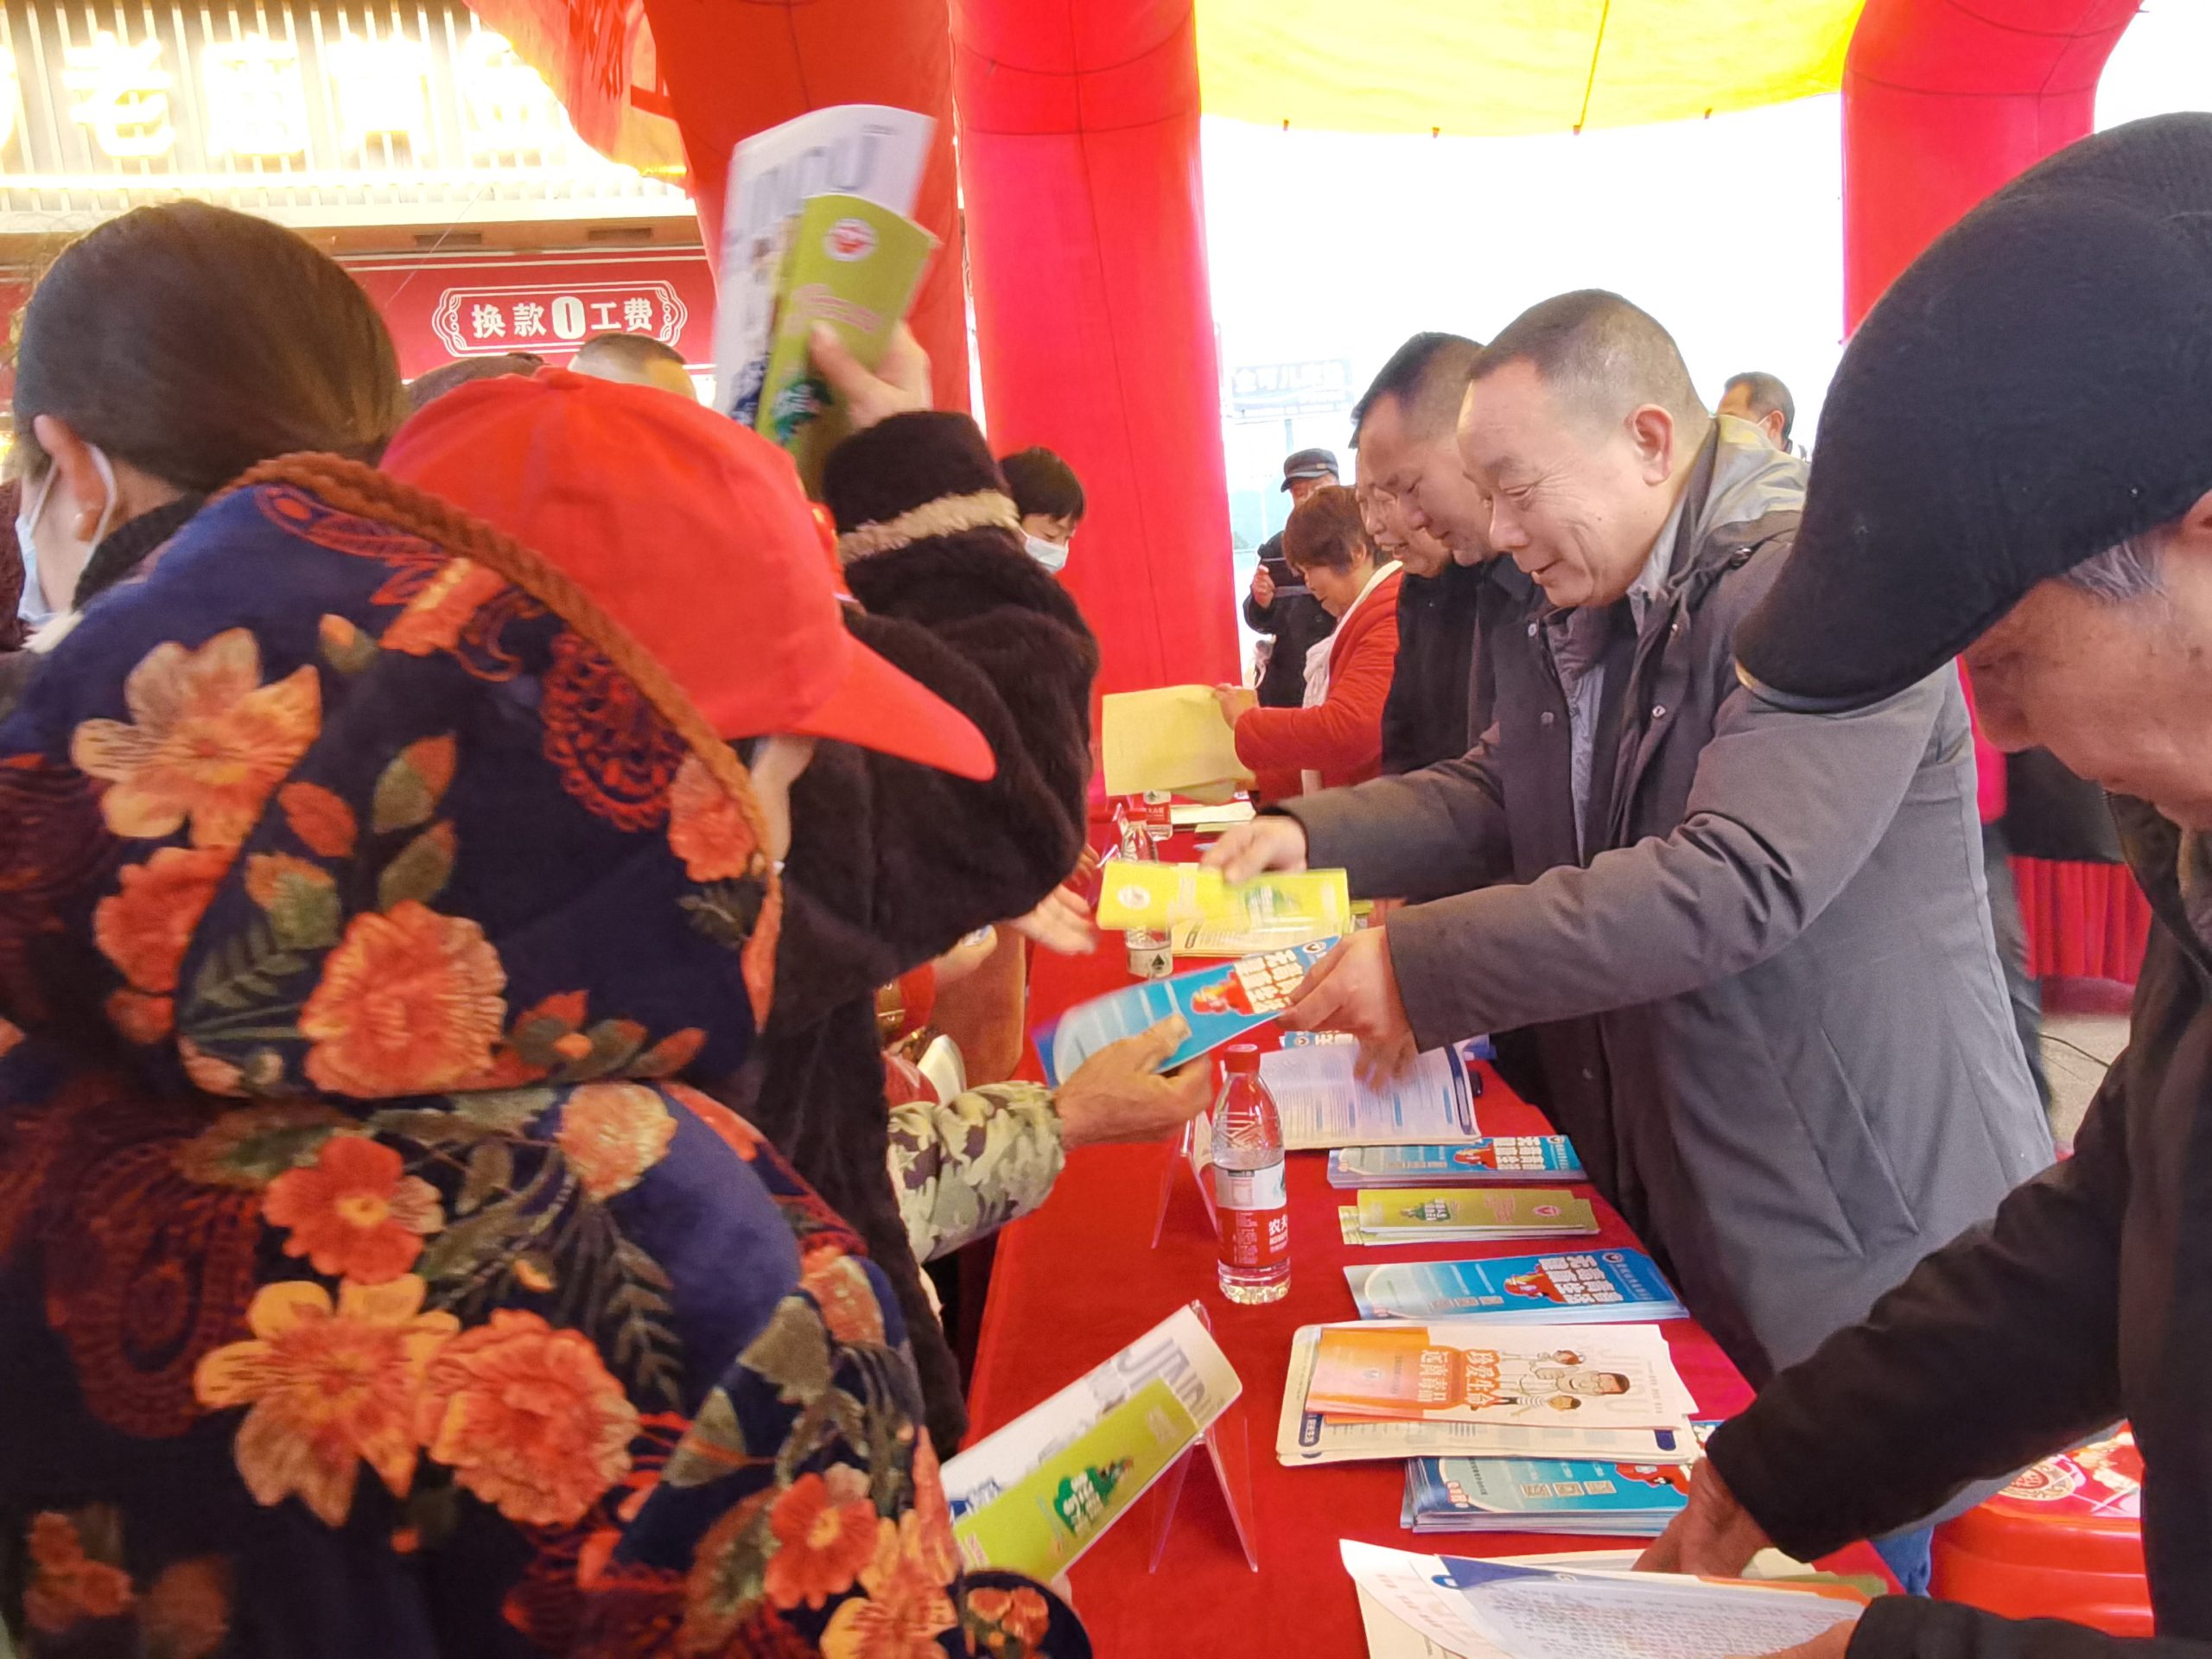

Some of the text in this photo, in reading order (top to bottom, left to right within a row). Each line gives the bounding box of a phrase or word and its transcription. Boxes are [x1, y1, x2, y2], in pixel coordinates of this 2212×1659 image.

[471, 296, 654, 340] 换款0工费
[1417, 1350, 1449, 1402] 远离毒品
[1465, 1350, 1497, 1406] 珍爱生命
